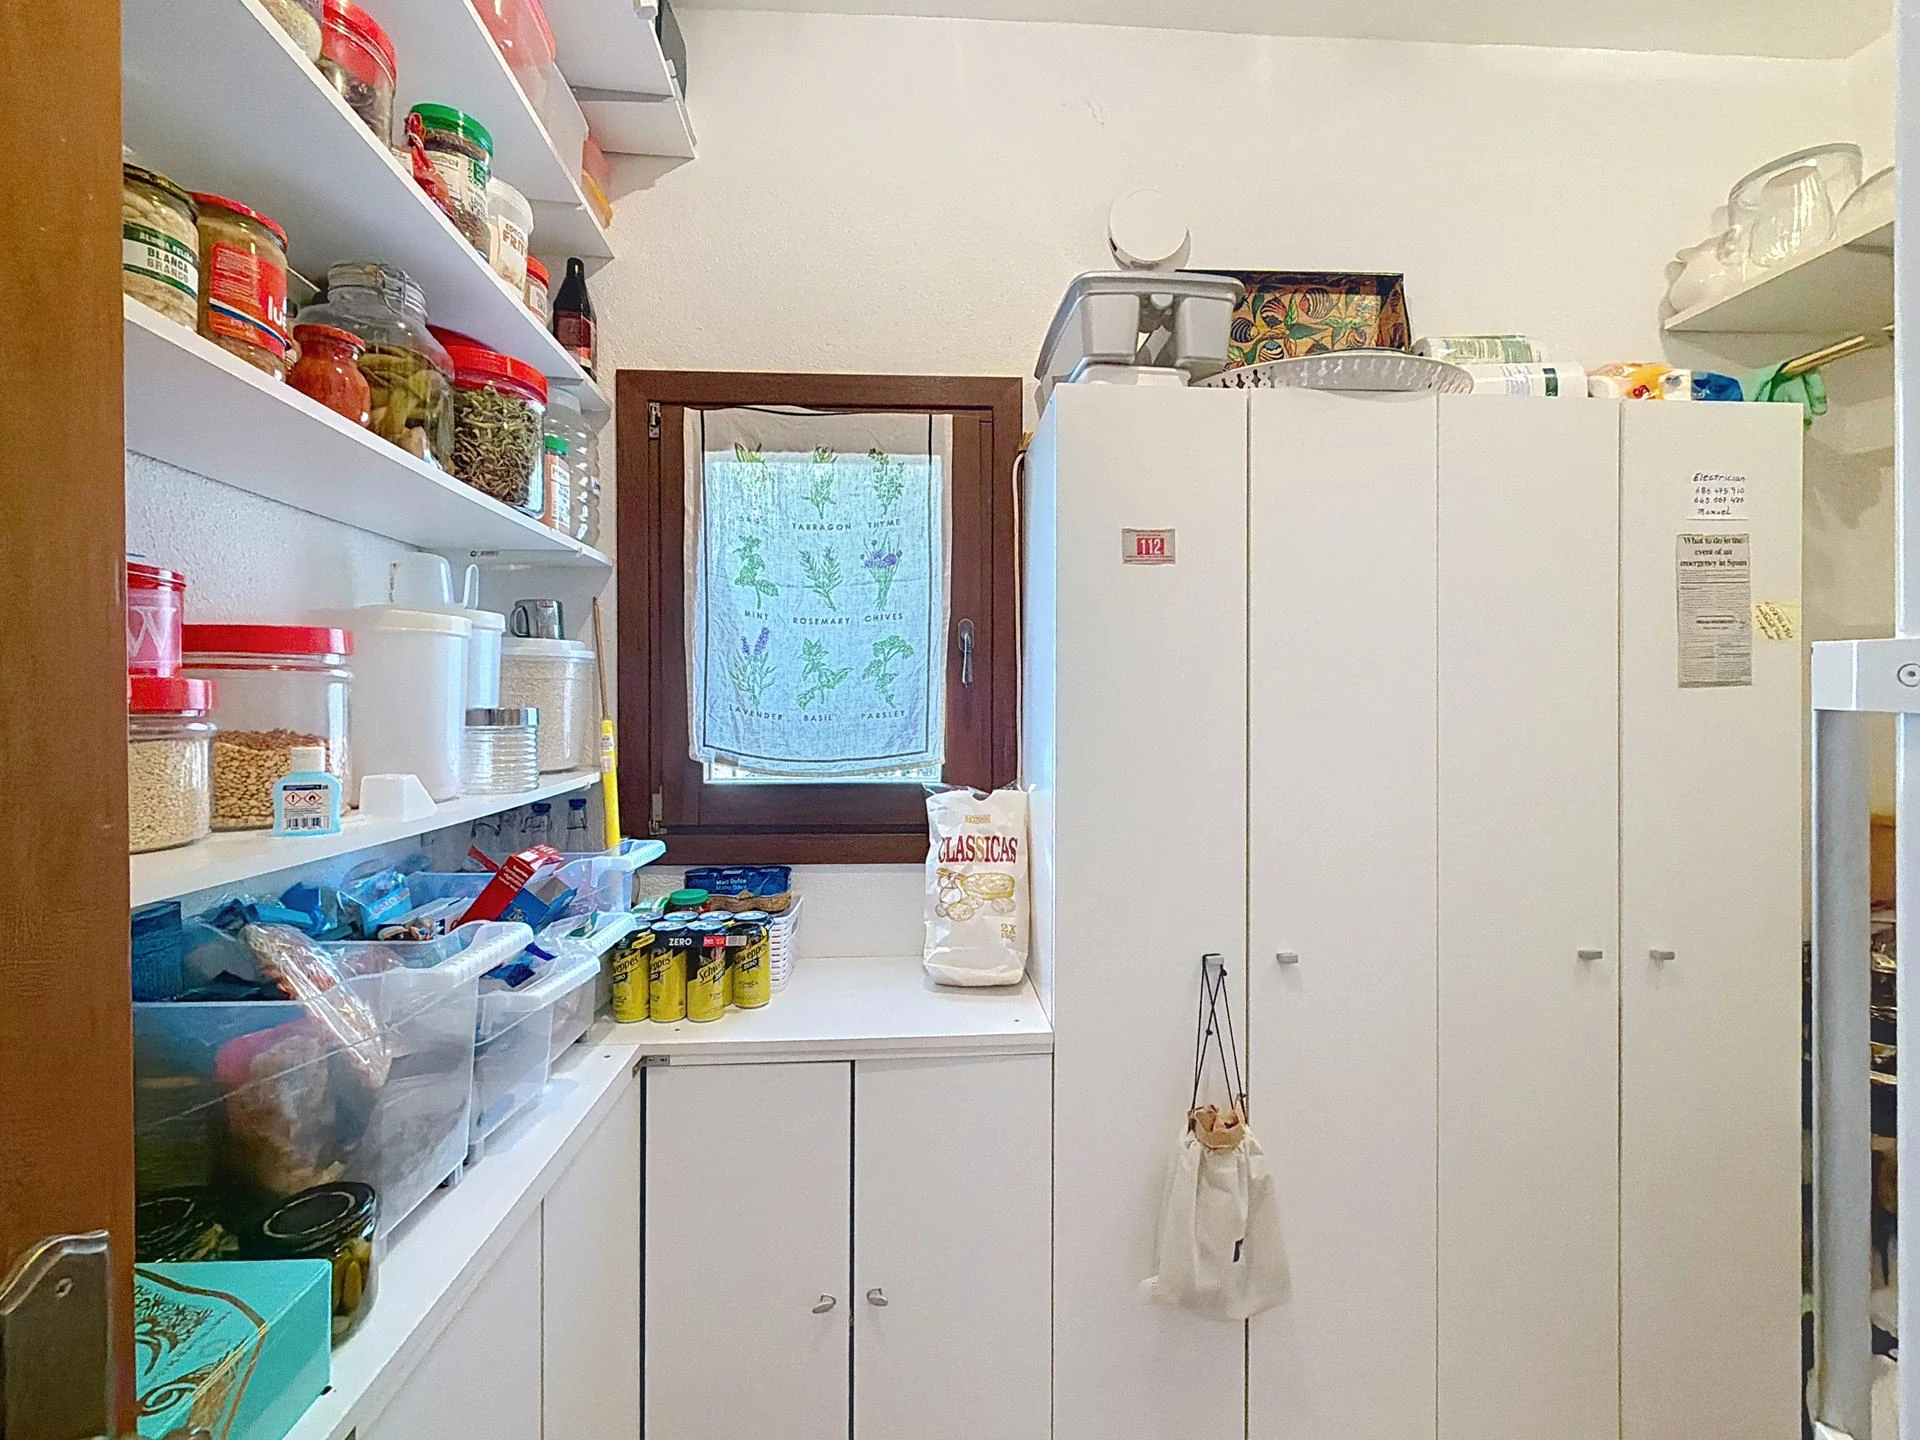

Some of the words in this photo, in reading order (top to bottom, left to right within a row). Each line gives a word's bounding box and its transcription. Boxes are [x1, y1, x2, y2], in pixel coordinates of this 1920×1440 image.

[147, 247, 189, 274] BLANCA
[147, 258, 189, 284] BRANCO
[1693, 472, 1746, 483] Electrician
[792, 522, 851, 531] TARRAGON
[868, 518, 901, 529] THYME
[1140, 538, 1162, 554] 112
[744, 610, 769, 621] MINT
[793, 616, 851, 625] ROSEMARY
[864, 612, 904, 622] CHIVES
[729, 704, 784, 721] LAVENDER
[803, 713, 833, 722] BASIL
[860, 710, 906, 720] PARSLEY
[938, 834, 1018, 863] CLASSICAS
[668, 936, 692, 946] ZERO
